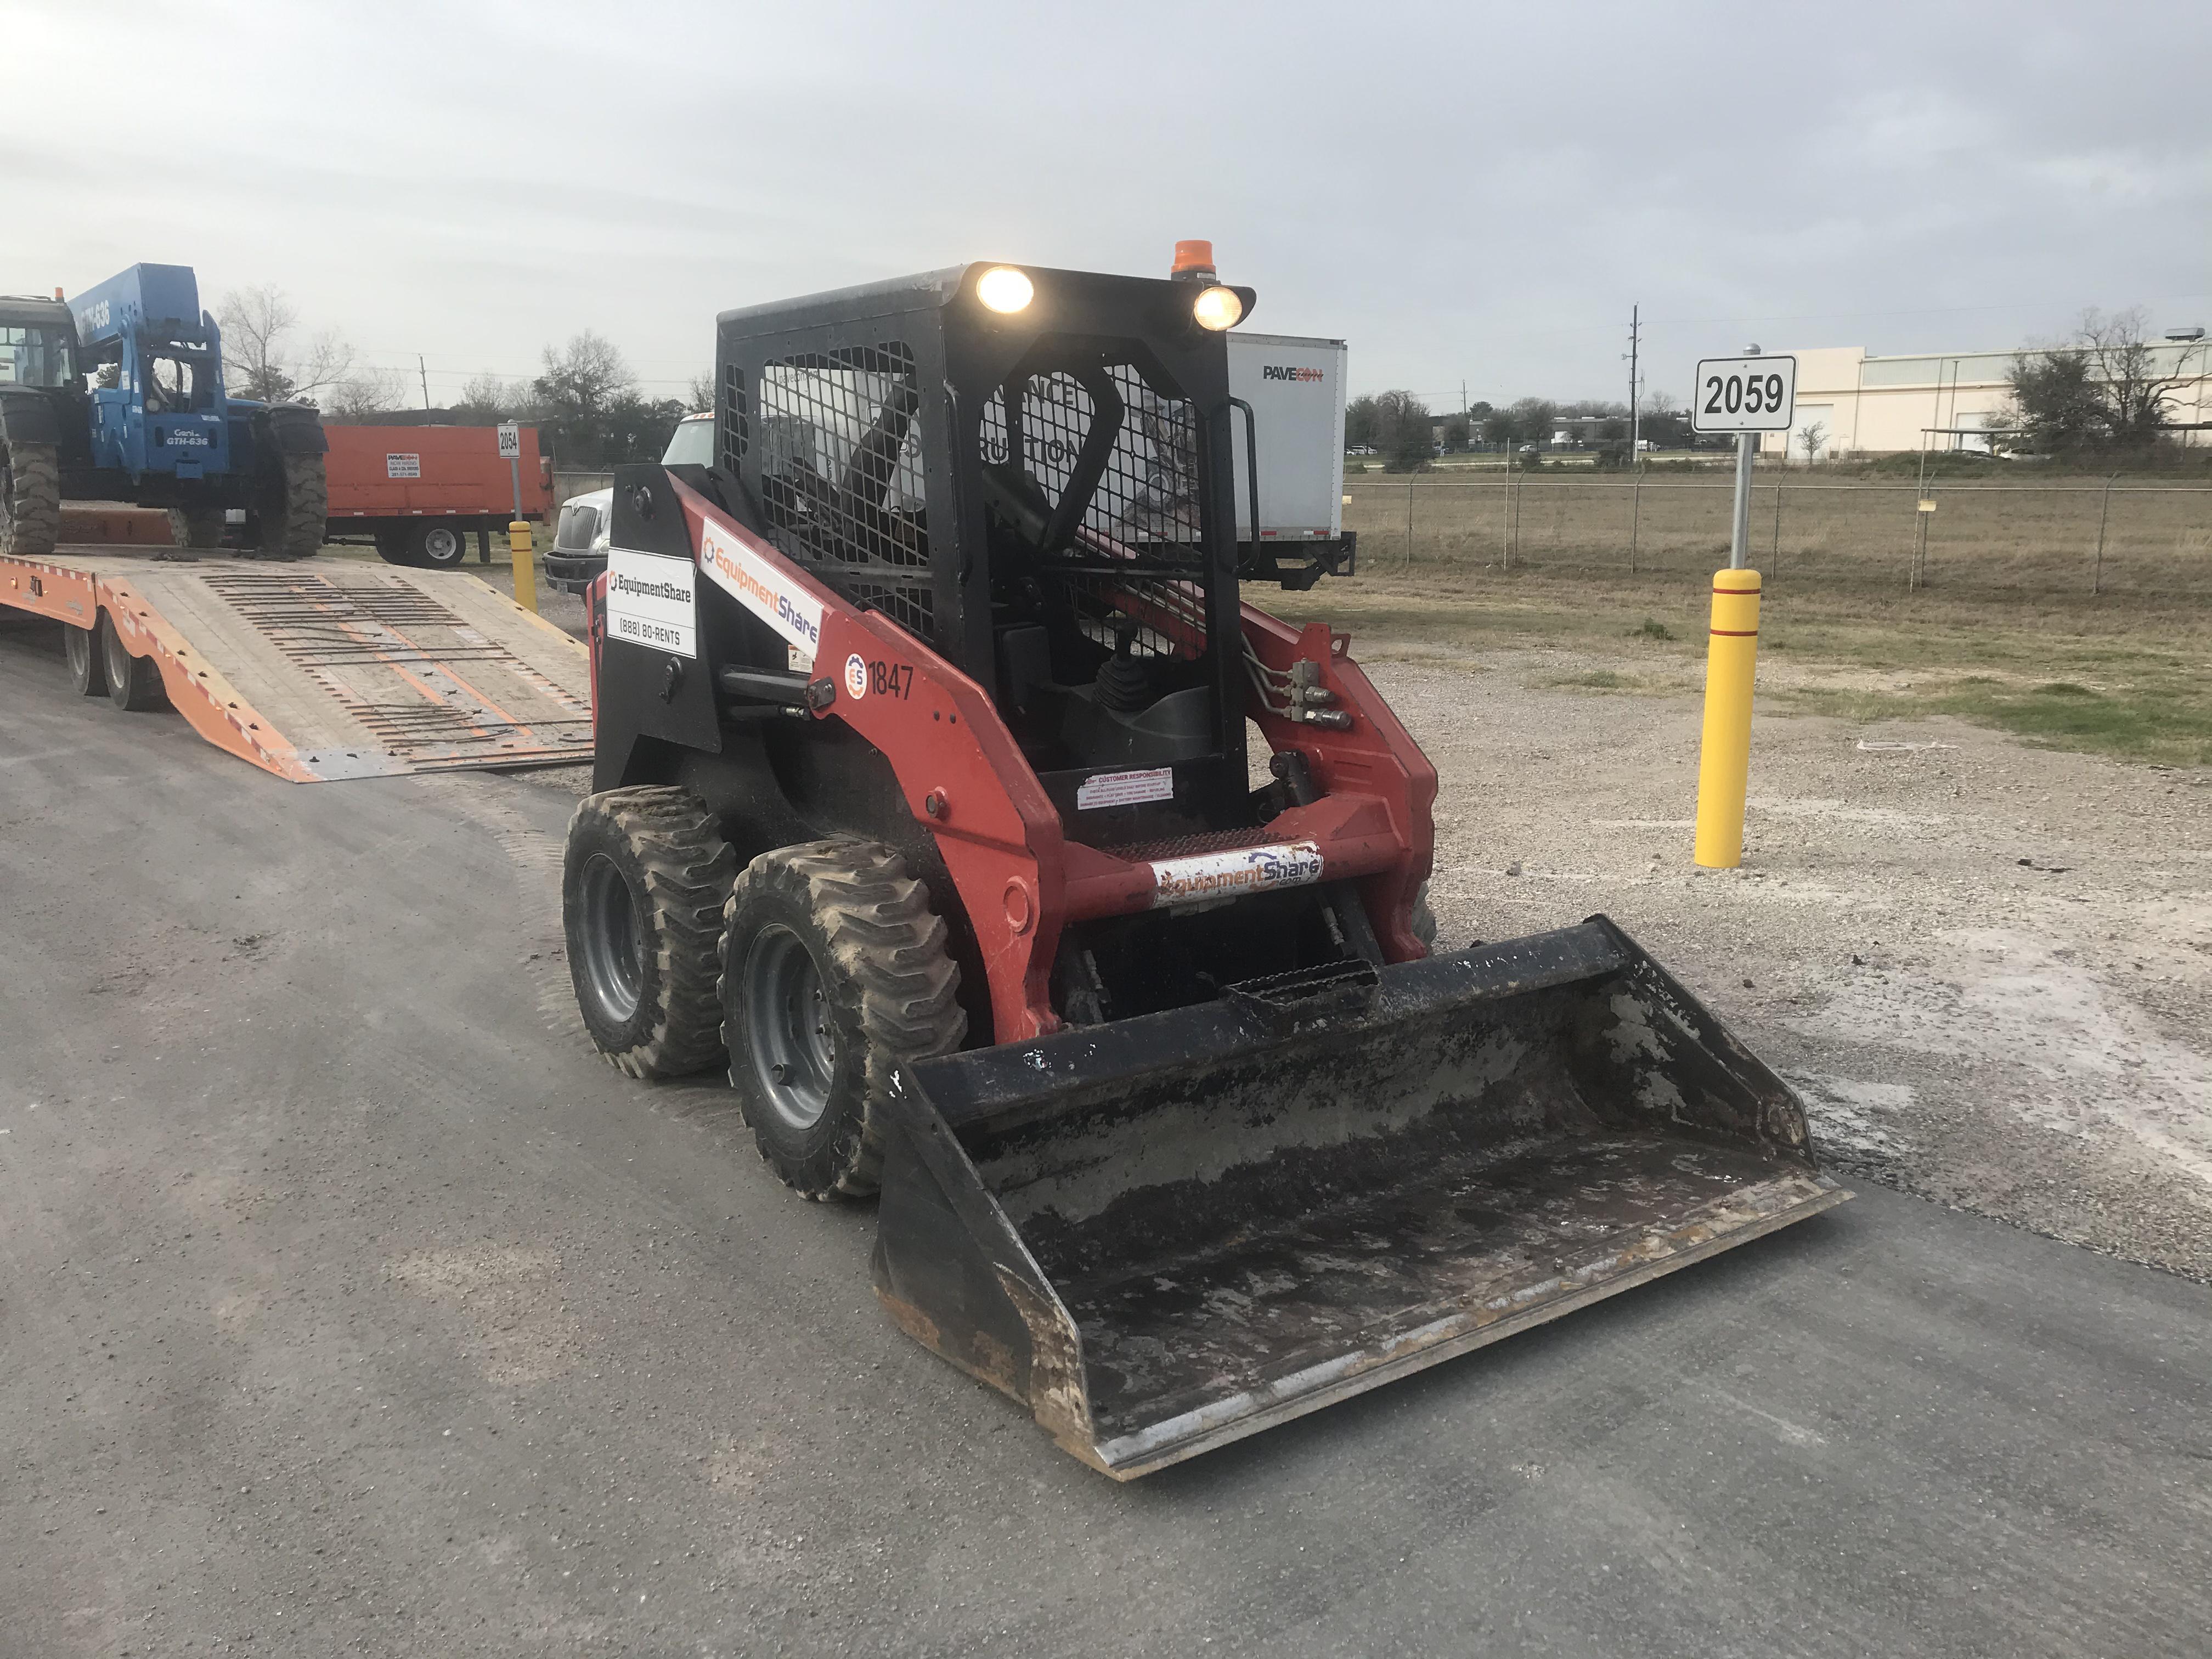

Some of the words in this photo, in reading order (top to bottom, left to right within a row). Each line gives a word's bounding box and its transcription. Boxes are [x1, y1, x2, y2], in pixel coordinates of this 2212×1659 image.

[779, 370, 819, 383] pavecon.om
[1263, 365, 1324, 382] PAVECON
[1705, 374, 1784, 414] 2059
[167, 437, 208, 445] GTH-636
[500, 432, 517, 450] 2054
[618, 574, 691, 603] EquipmentShare
[715, 547, 818, 644] EquipmentShare
[620, 617, 640, 636] (888)
[642, 624, 680, 646] 80-RENTS
[849, 668, 863, 685] ES
[868, 661, 914, 701] 1847
[1099, 774, 1128, 783] CUSTOMER
[1129, 770, 1171, 780] RESPONSIBILITY
